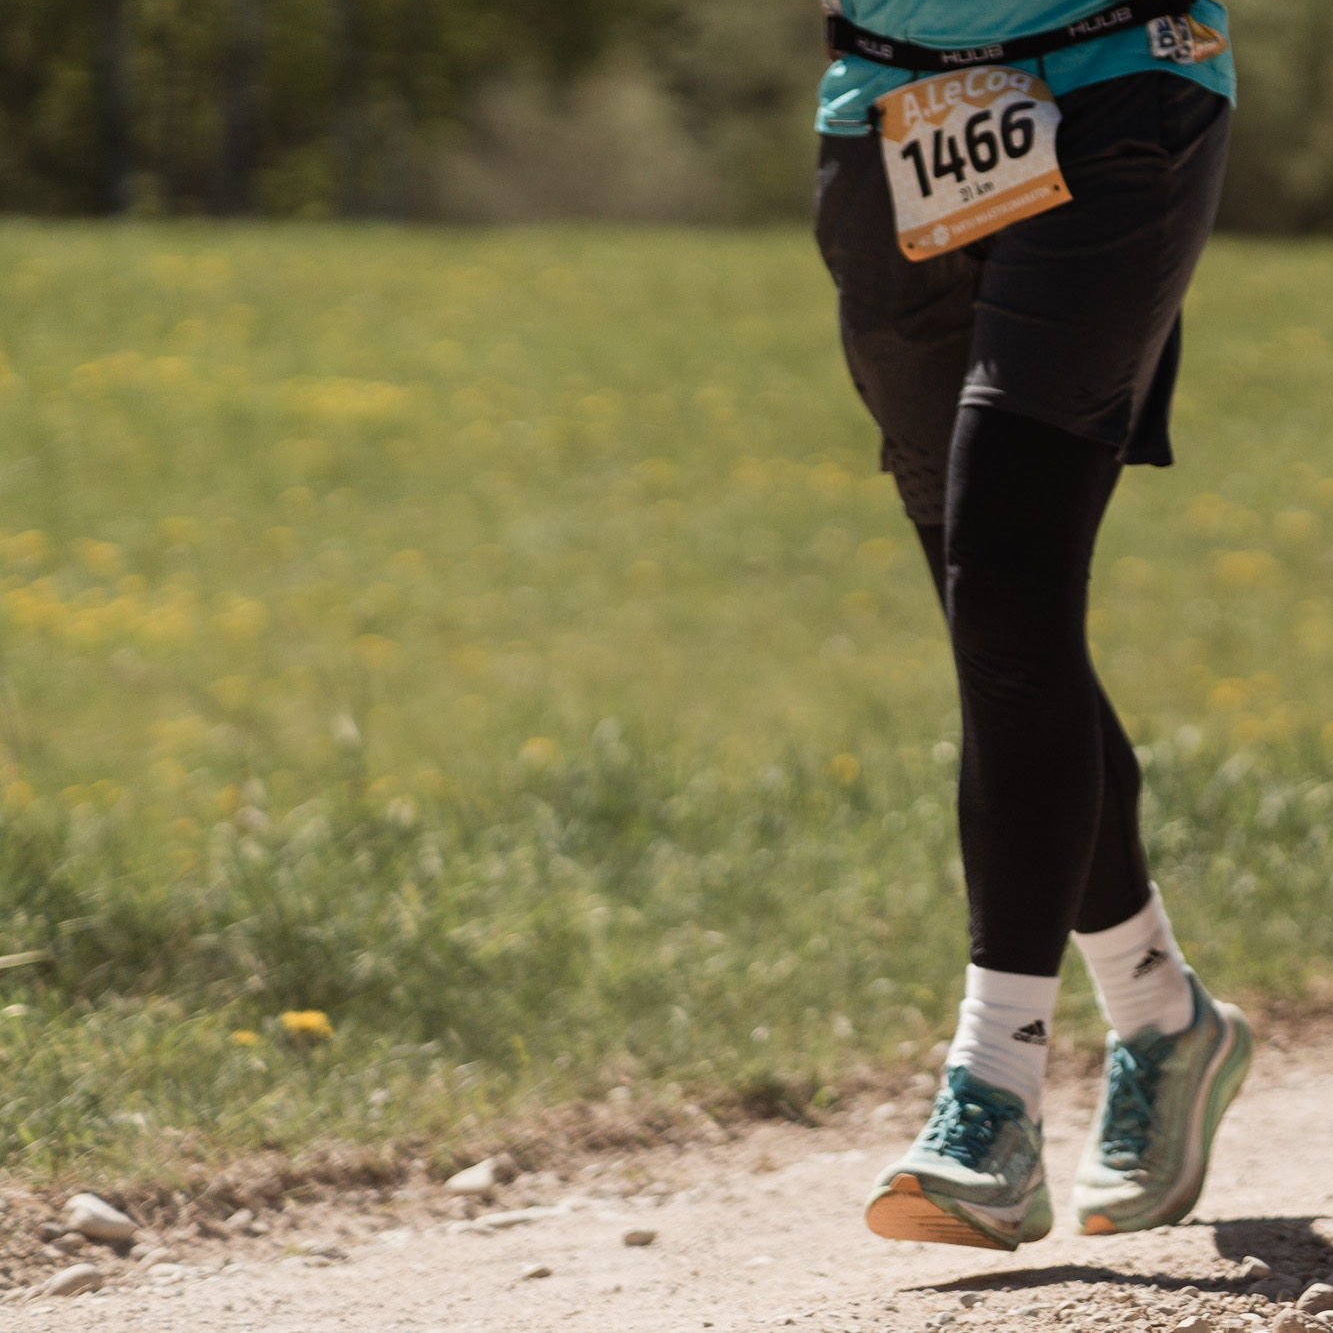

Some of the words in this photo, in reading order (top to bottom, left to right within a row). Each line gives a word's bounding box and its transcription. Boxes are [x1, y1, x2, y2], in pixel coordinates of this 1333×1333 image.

[1068, 6, 1133, 37] HUUB
[940, 43, 1005, 64] HUUB
[901, 100, 1037, 199] 1466
[959, 185, 975, 202] 21
